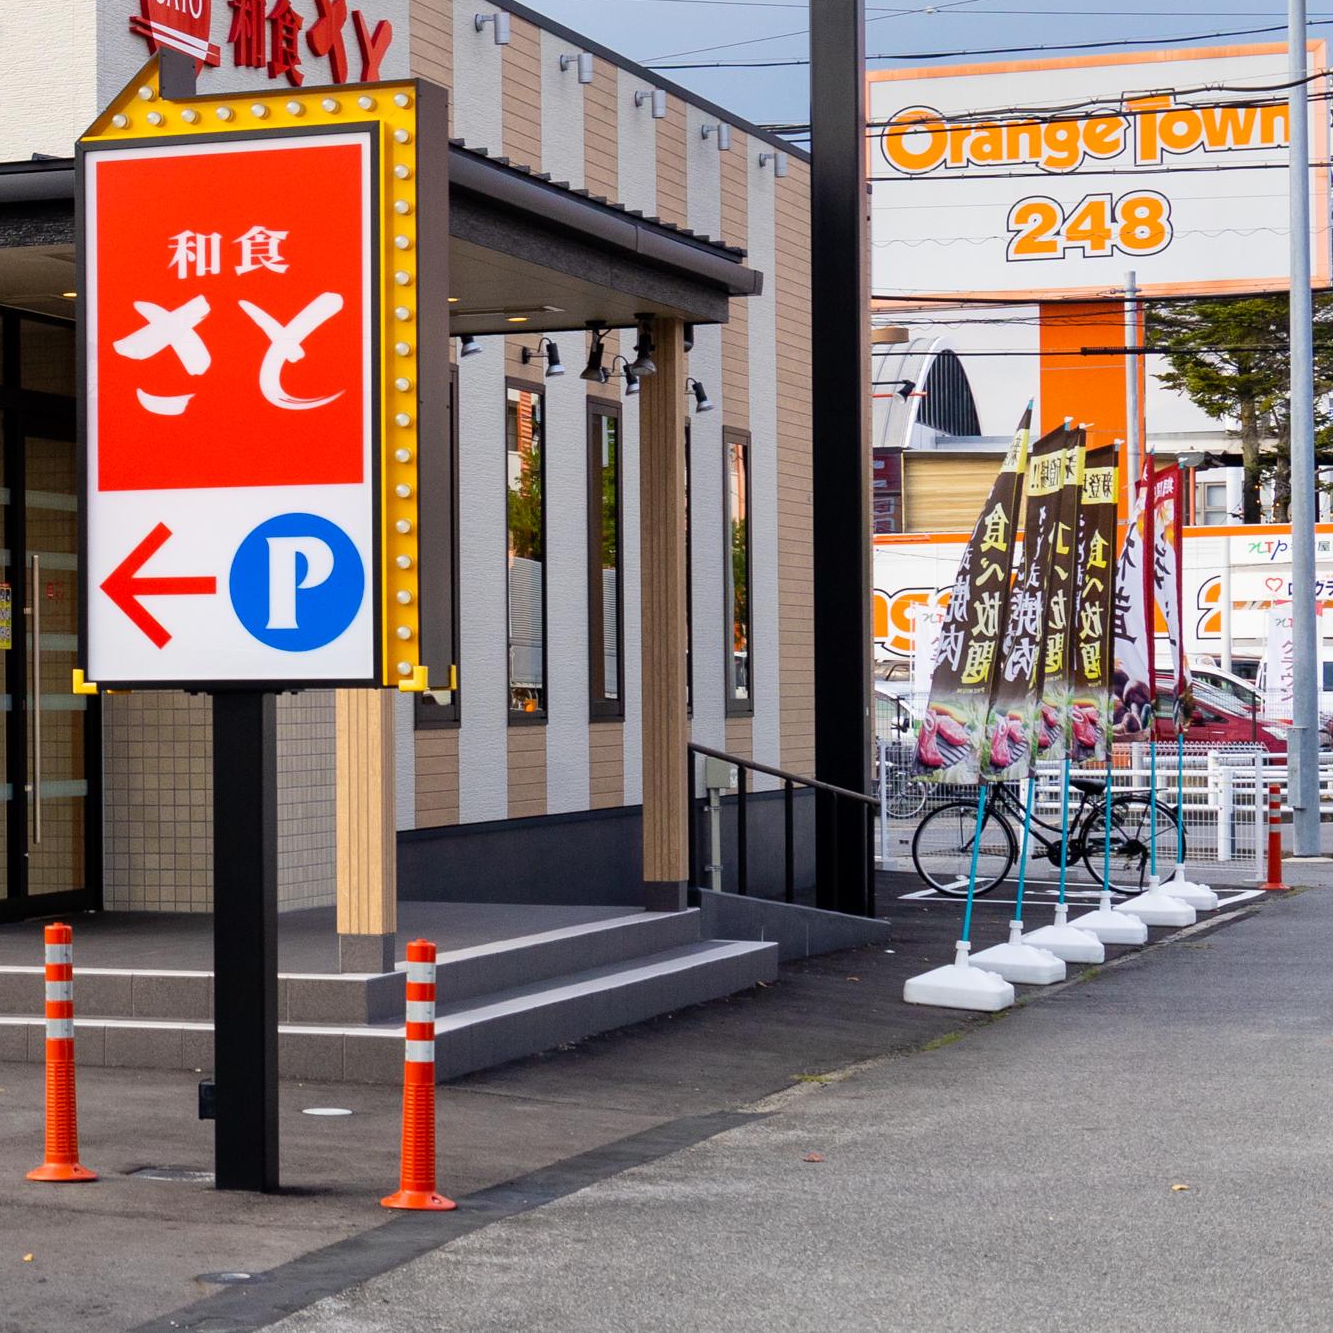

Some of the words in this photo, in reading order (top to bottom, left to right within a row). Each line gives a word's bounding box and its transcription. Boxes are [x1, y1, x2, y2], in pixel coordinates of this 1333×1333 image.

[168, 225, 289, 279] 和食
[1007, 190, 1173, 261] 248
[113, 292, 345, 416] さと
[265, 536, 335, 630] P
